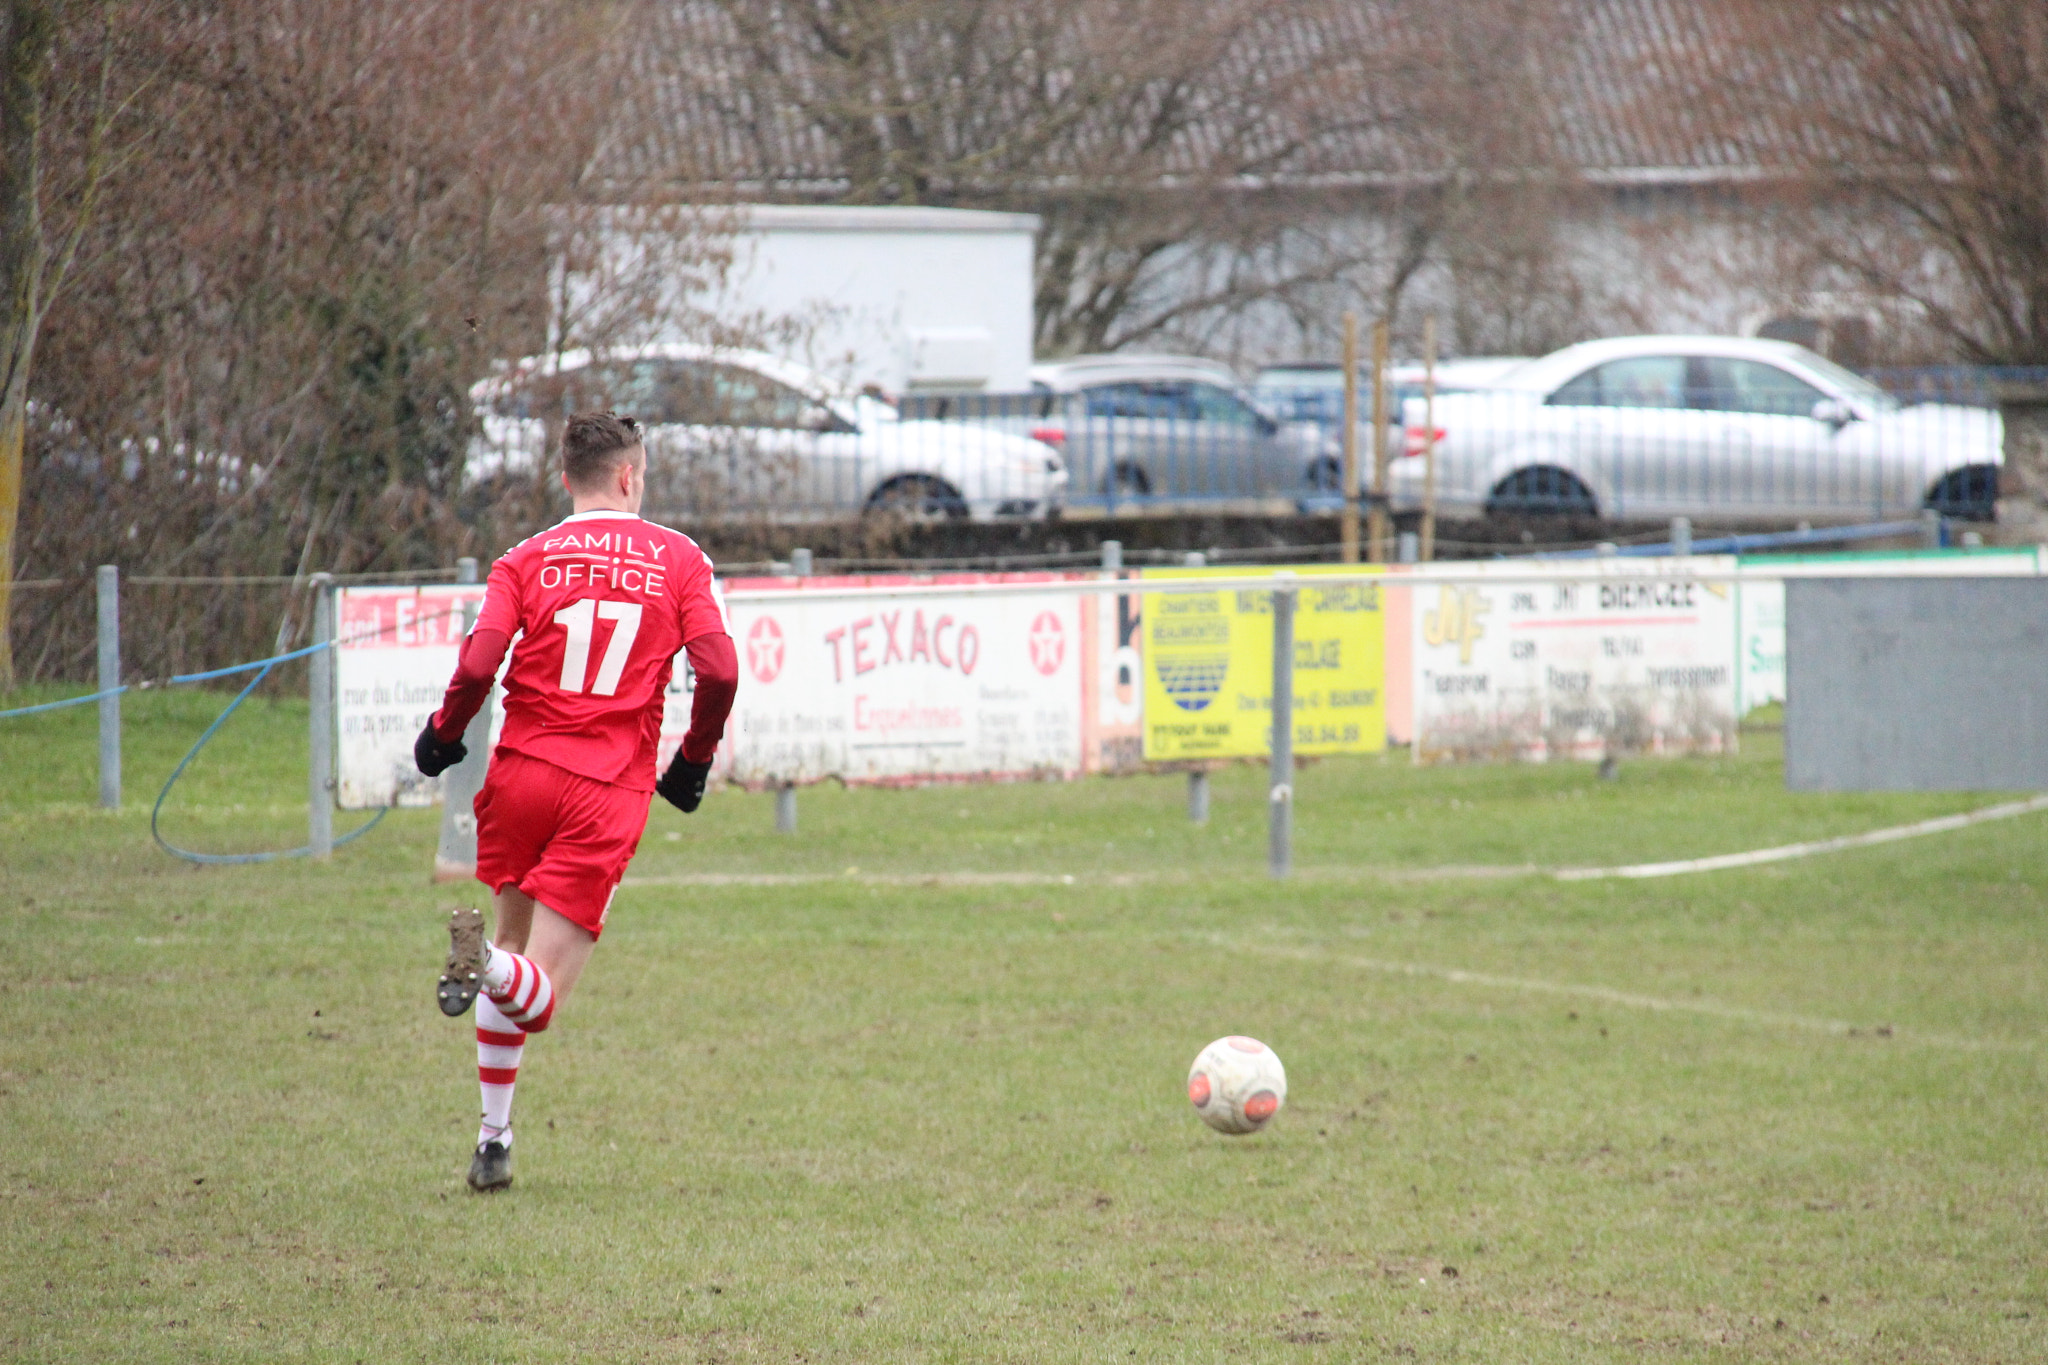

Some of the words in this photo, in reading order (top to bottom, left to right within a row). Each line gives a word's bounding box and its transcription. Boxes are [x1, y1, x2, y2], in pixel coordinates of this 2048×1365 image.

[543, 533, 666, 559] FAMILY
[553, 598, 643, 696] 17
[825, 608, 980, 683] TEXACO
